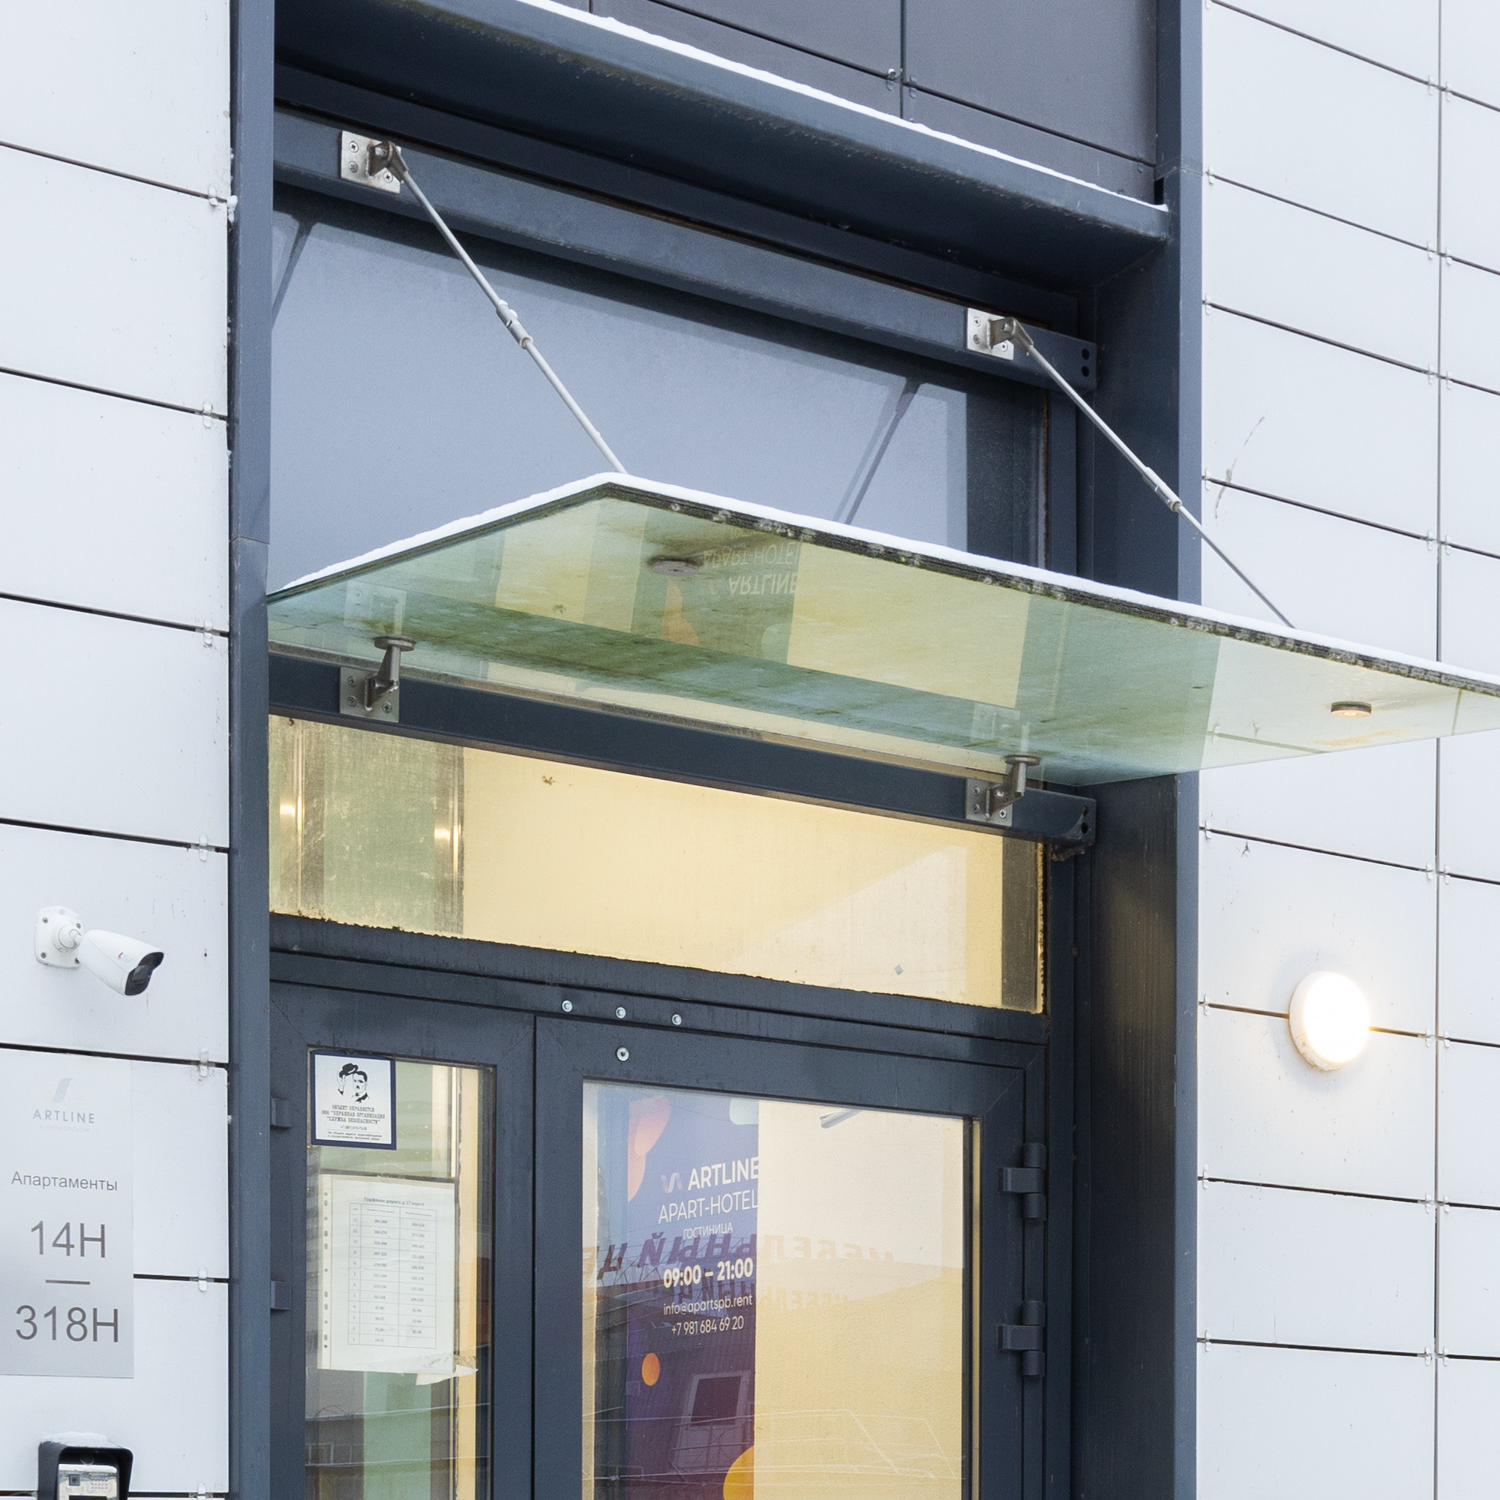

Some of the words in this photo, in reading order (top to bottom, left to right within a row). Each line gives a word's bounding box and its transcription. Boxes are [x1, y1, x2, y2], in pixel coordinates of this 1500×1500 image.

[32, 1109, 95, 1124] ARTLINE
[11, 1171, 118, 1191] Апартаменты
[688, 1156, 759, 1191] ARTLINE
[658, 1189, 759, 1224] APART-HOTEL
[31, 1220, 105, 1258] 14Н
[684, 1222, 734, 1240] ГОСТИНИЦА
[664, 1265, 702, 1289] 09:00
[717, 1257, 754, 1281] 21:00
[663, 1294, 753, 1315] info@apartspb.rent
[16, 1305, 119, 1343] 318Н
[672, 1322, 682, 1336] +7
[684, 1321, 698, 1336] 981
[700, 1319, 717, 1334] 684
[719, 1317, 731, 1332] 69
[732, 1315, 745, 1330] 20
